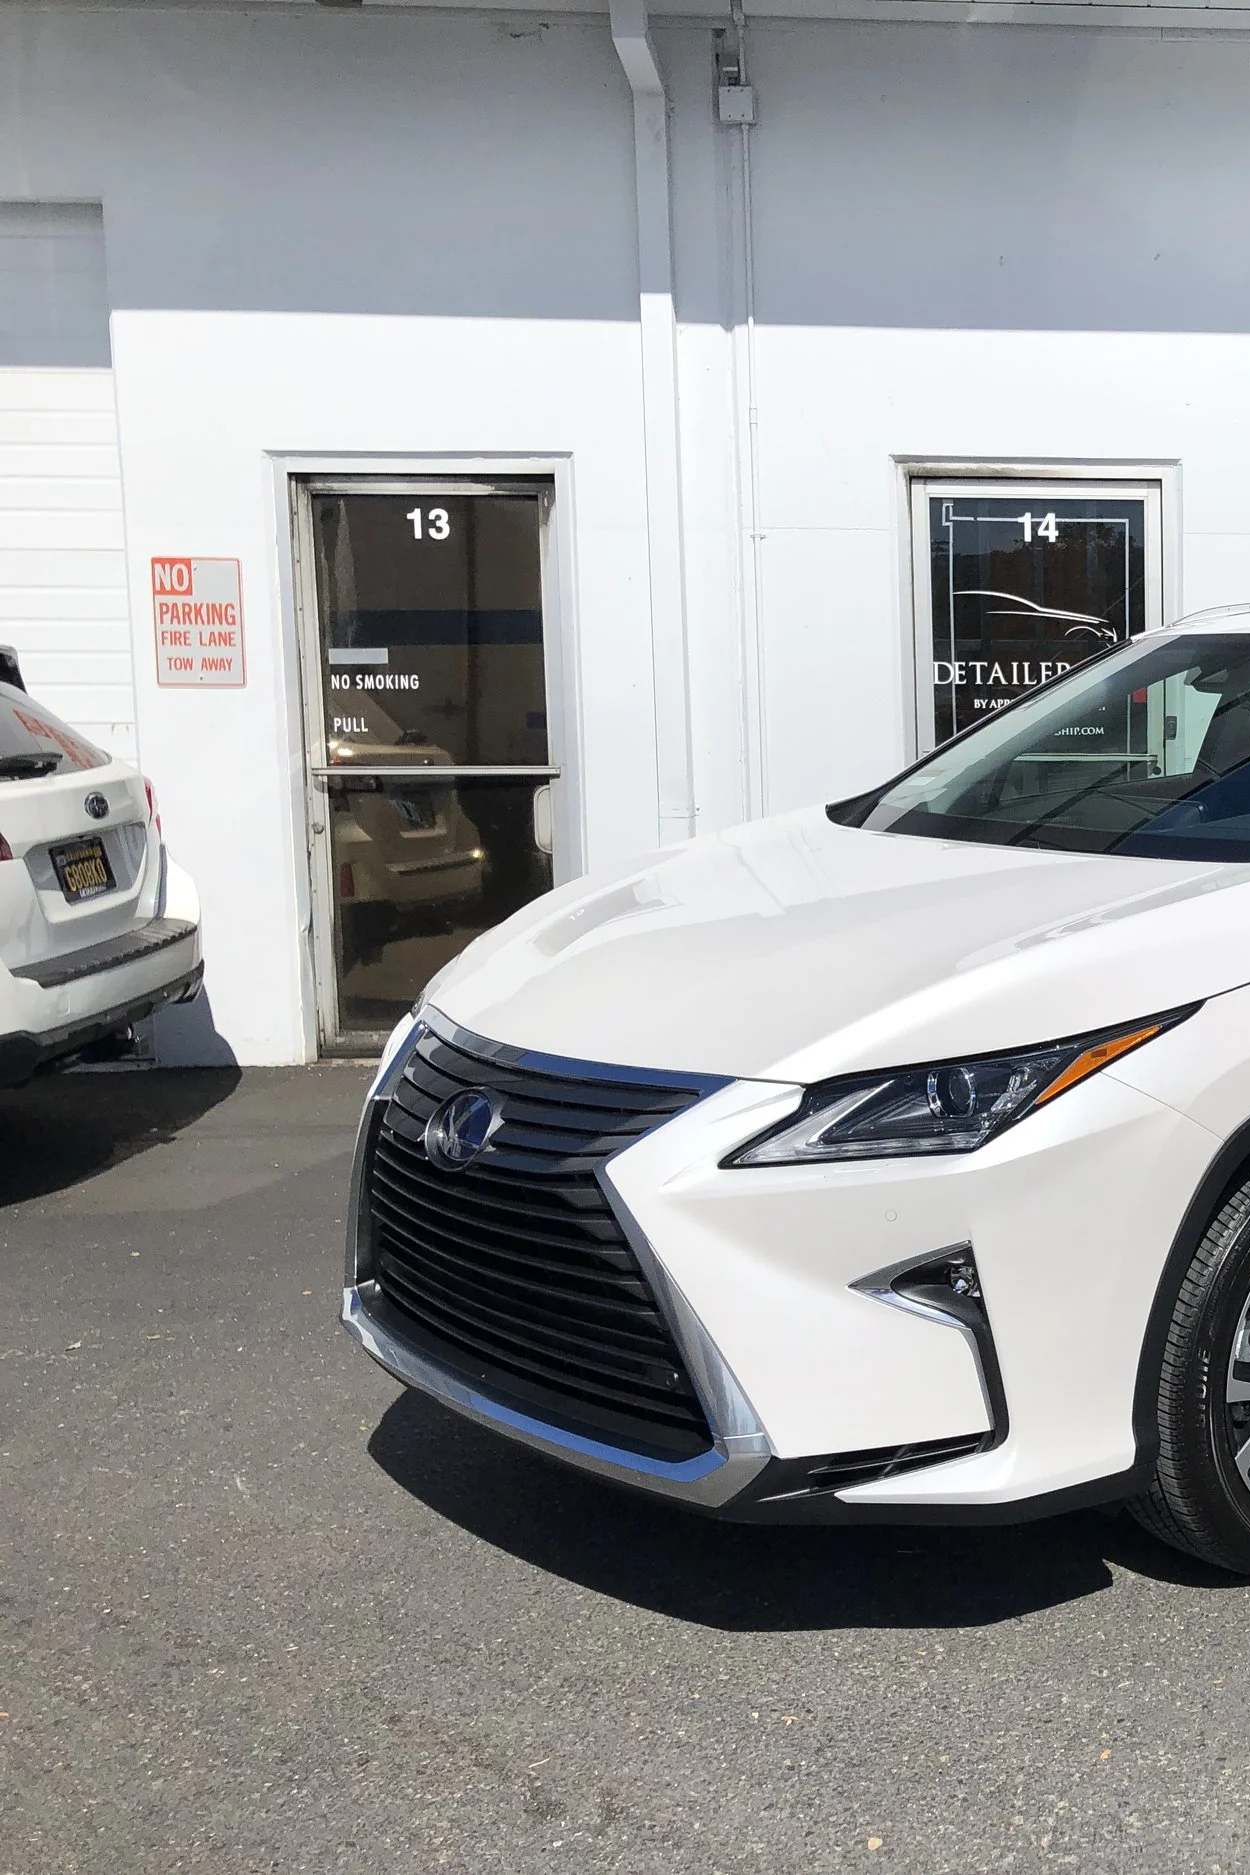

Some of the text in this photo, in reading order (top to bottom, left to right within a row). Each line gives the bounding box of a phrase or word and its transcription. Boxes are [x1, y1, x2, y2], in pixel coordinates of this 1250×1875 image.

[406, 507, 450, 540] 13
[1018, 512, 1059, 542] 14
[154, 563, 189, 592] NO
[159, 602, 236, 626] PARKING
[161, 630, 236, 647] FIRE LANE
[167, 657, 232, 671] TOW AWAY
[331, 674, 420, 690] NO SMOKING
[974, 699, 988, 709] BY
[334, 717, 369, 733] PULL
